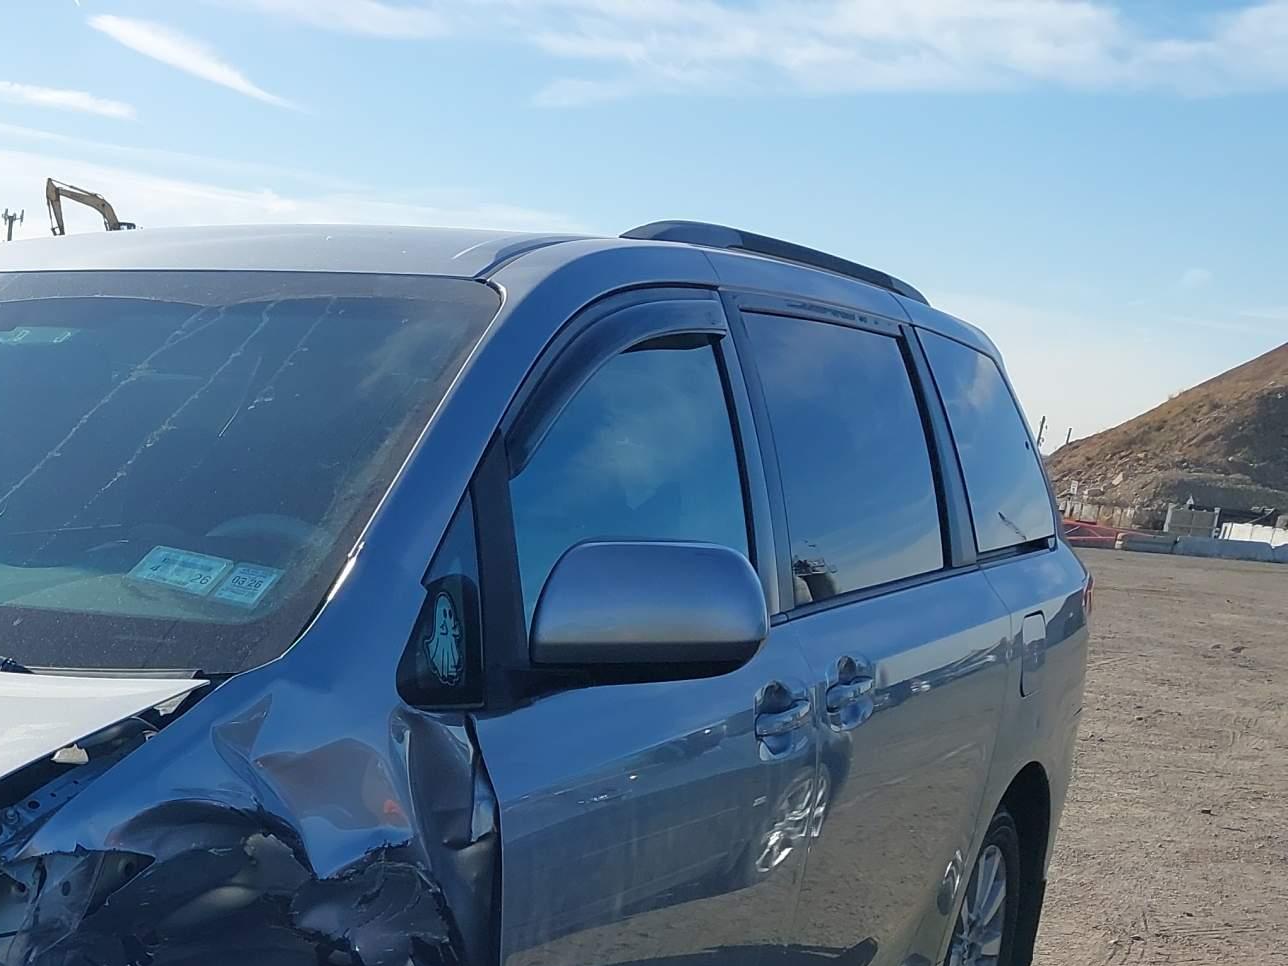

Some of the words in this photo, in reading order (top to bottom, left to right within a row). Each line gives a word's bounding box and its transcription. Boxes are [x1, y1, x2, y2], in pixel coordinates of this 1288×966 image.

[190, 573, 212, 585] 26
[231, 575, 247, 585] 03
[247, 578, 264, 589] 26
